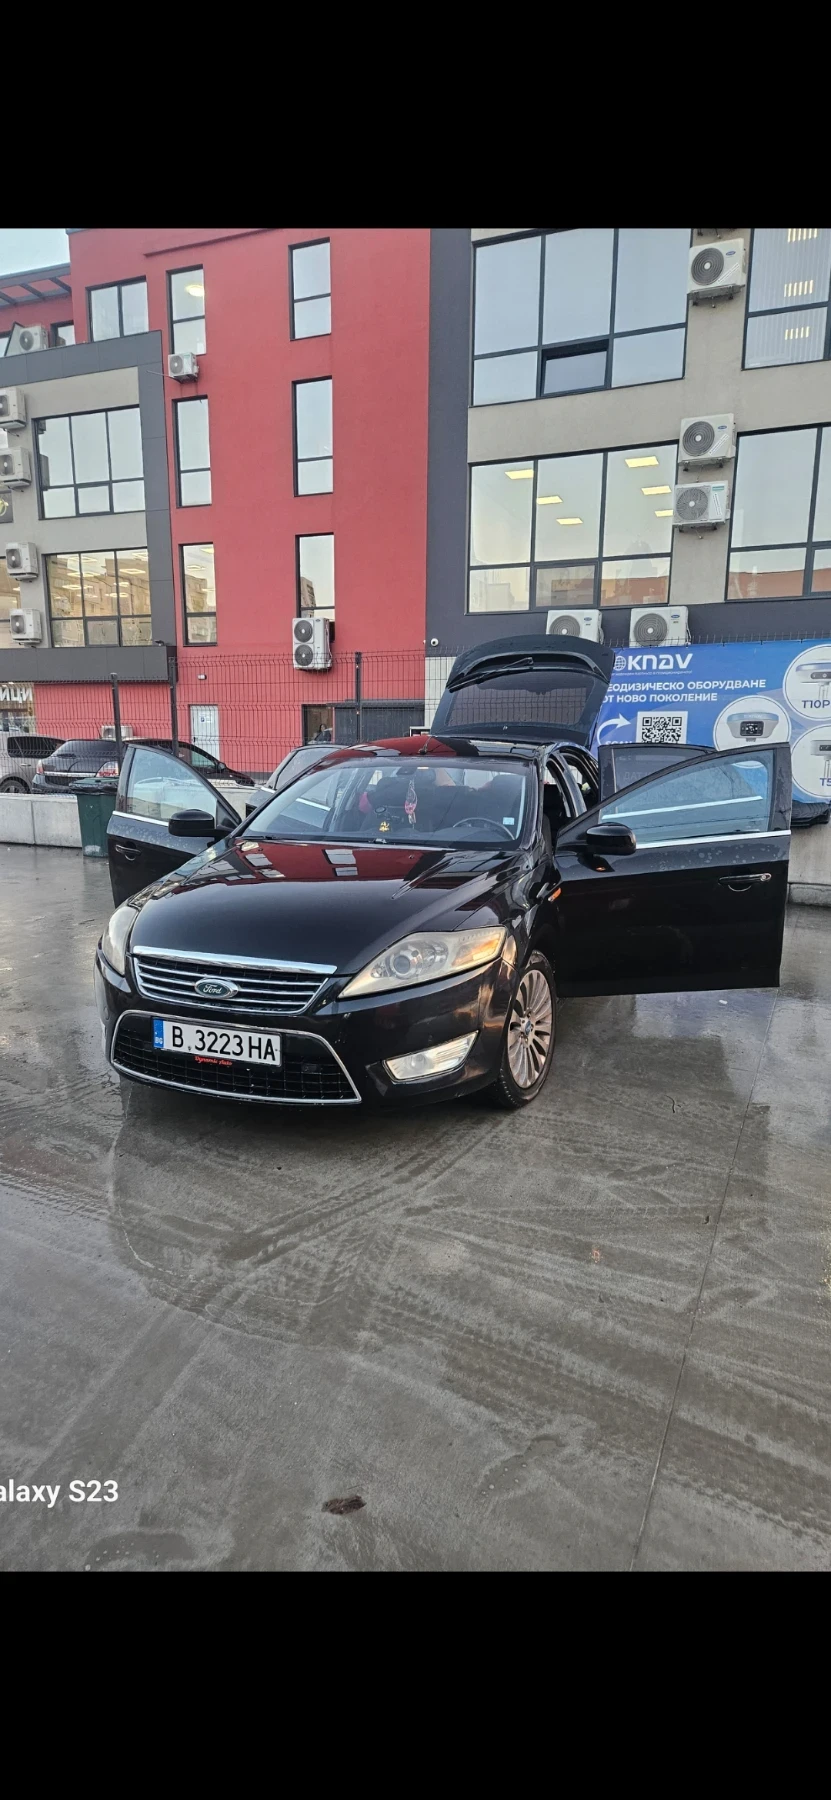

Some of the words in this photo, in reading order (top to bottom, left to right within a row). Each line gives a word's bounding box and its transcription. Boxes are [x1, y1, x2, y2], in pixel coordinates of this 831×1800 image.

[607, 681, 685, 693] ЕОДИЗИЧЕСКО
[687, 679, 767, 690] ОБОРУДВАНЕ
[616, 694, 647, 703] НОВО
[649, 692, 718, 702] ПОКОЛЕНИЕ
[202, 983, 223, 994] Ford
[195, 1029, 244, 1057] 3223
[248, 1036, 276, 1061] HA
